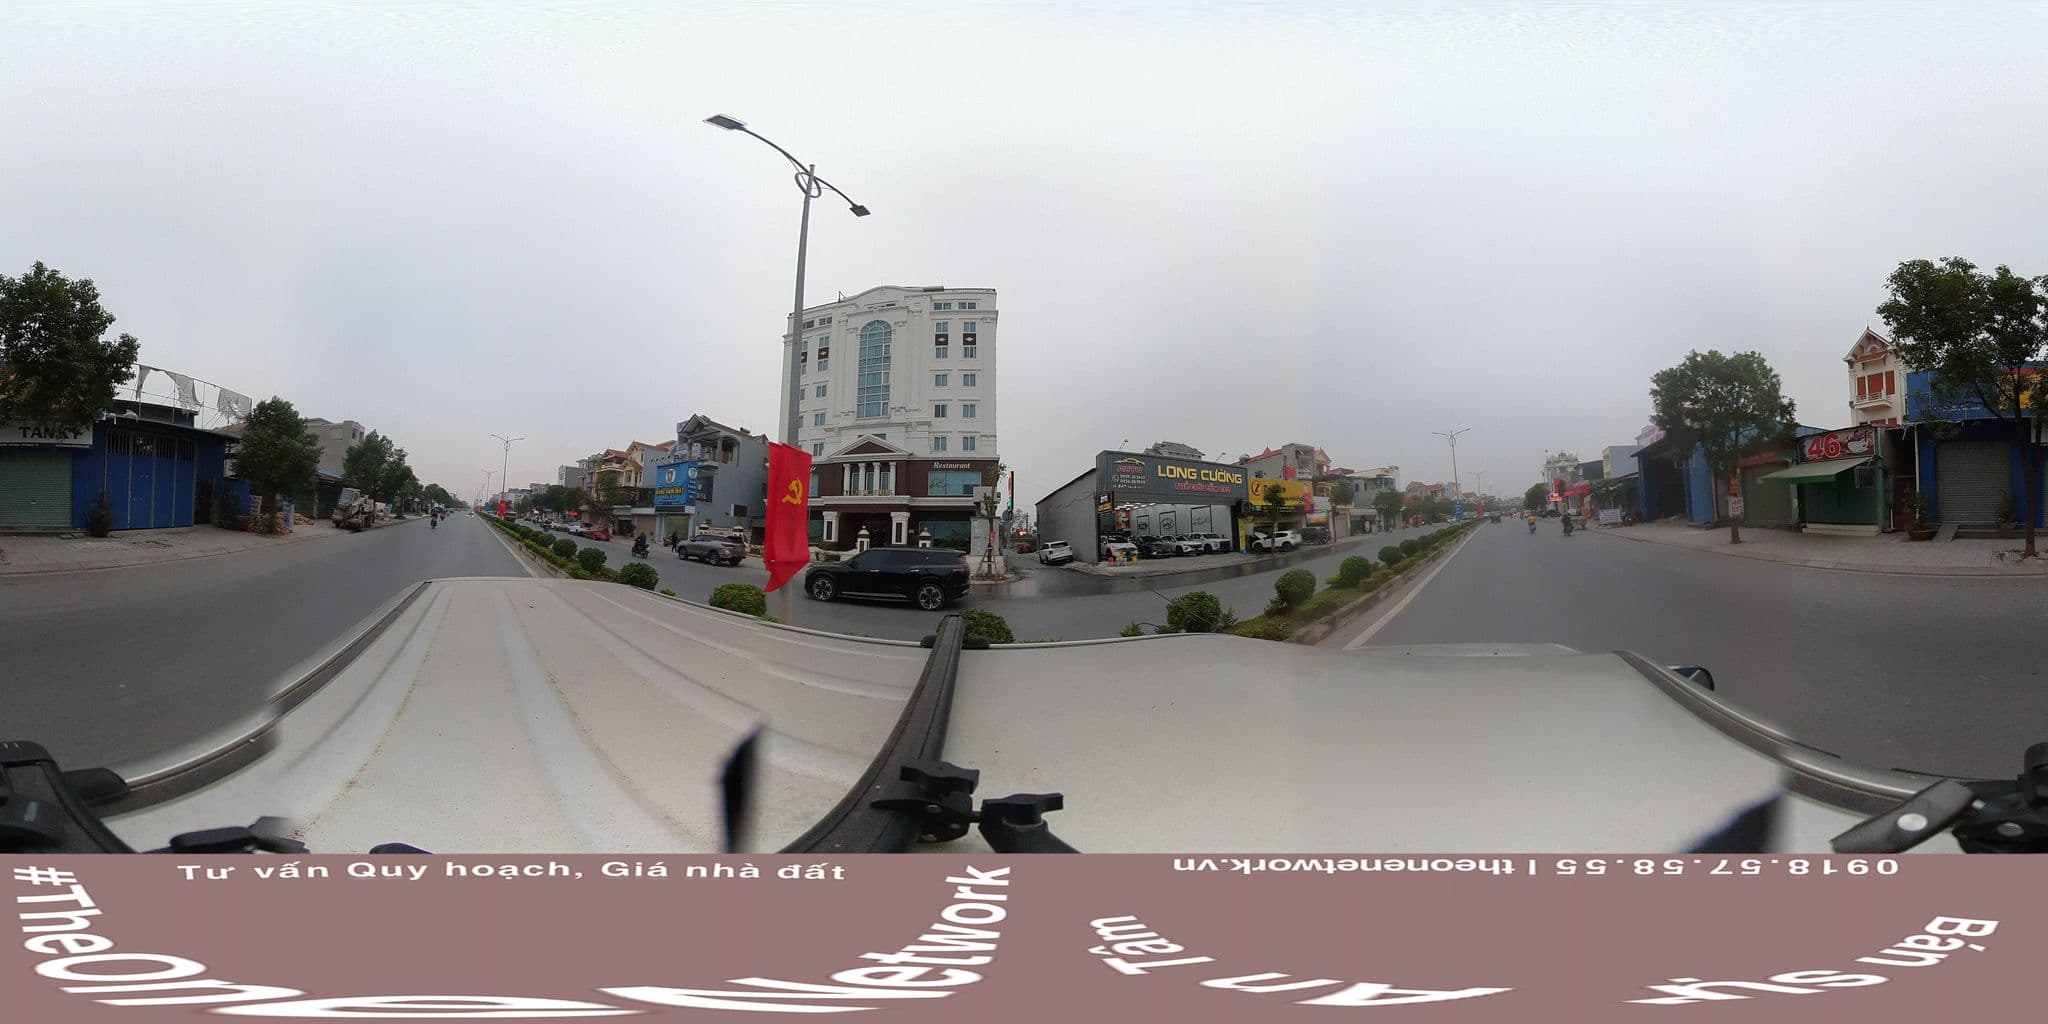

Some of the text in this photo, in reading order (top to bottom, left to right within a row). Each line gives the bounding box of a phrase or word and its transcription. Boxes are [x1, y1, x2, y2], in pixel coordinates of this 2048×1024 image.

[1807, 433, 1841, 460] 46
[933, 461, 971, 470] Restaurant
[1157, 464, 1243, 484] LONG CƯỜNG
